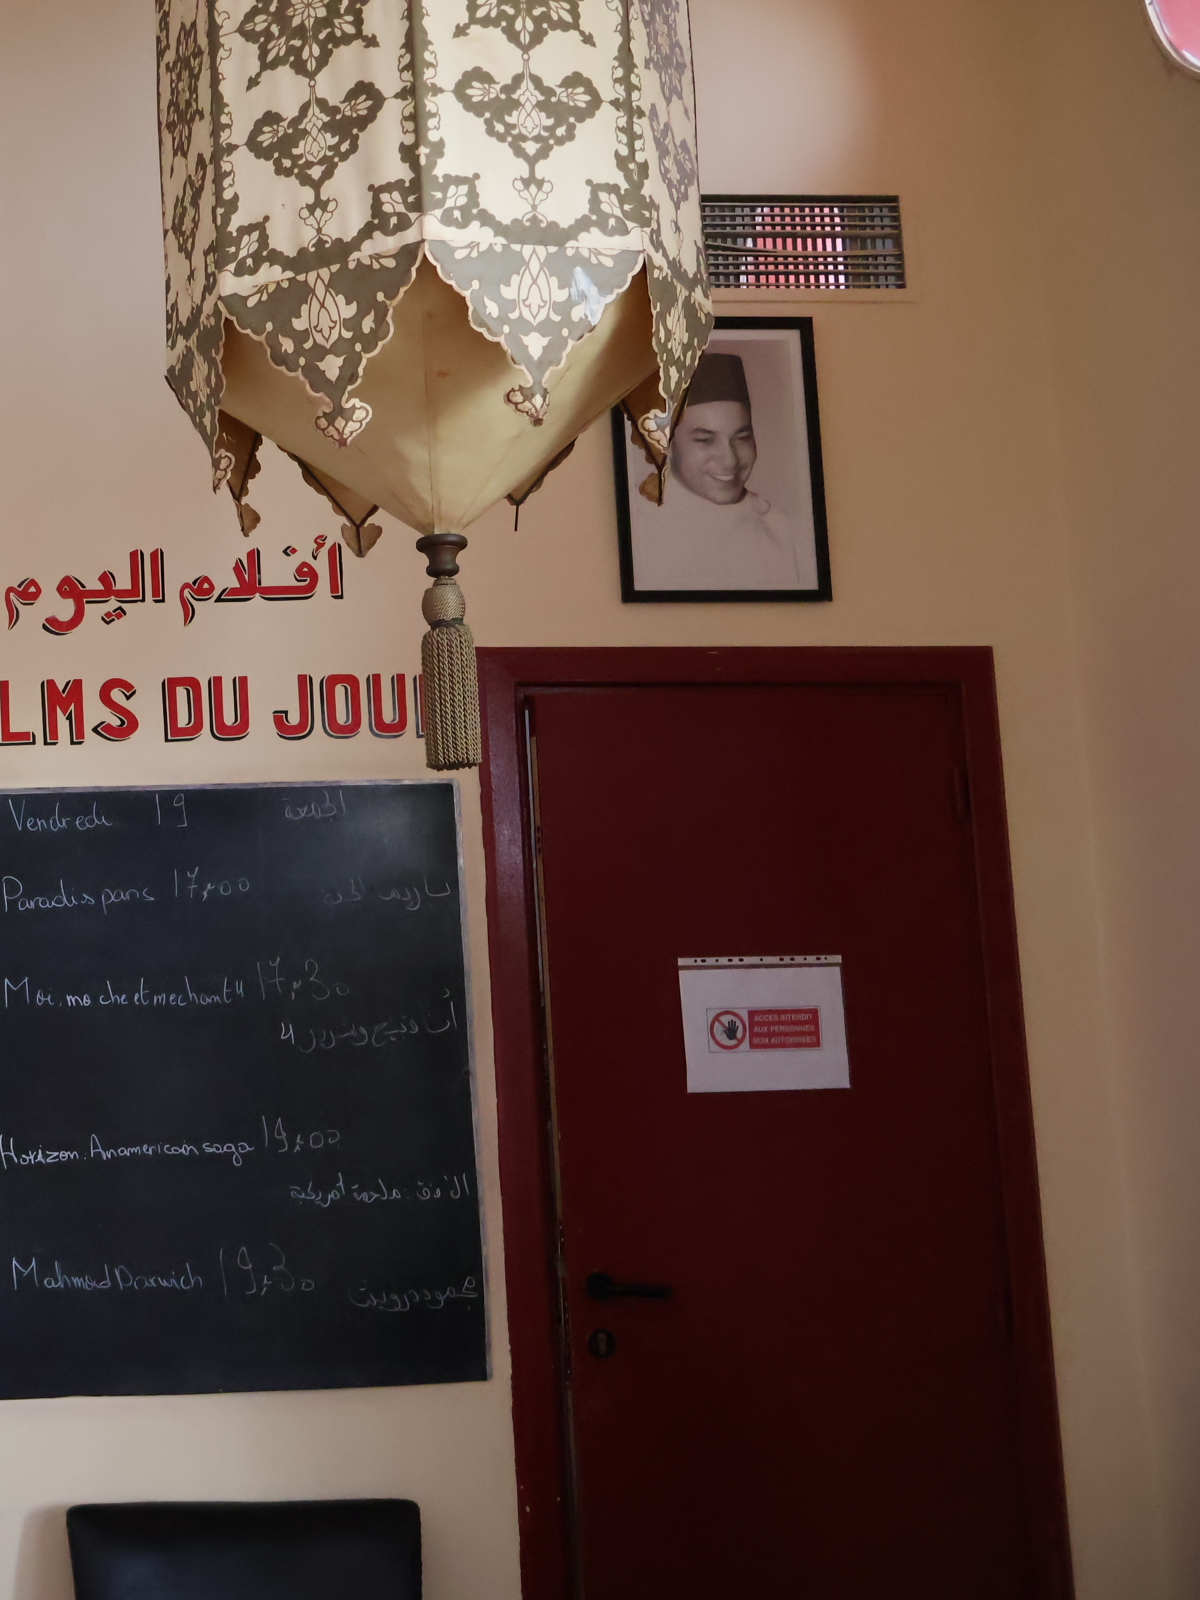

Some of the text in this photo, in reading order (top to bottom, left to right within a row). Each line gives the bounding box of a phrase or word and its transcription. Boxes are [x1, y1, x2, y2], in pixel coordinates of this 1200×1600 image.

[3, 533, 344, 636] أفلام اليوم
[162, 675, 250, 743] DU
[272, 672, 426, 740] JOU
[7, 793, 188, 832] Vendredi 19
[202, 1141, 255, 1167] saga
